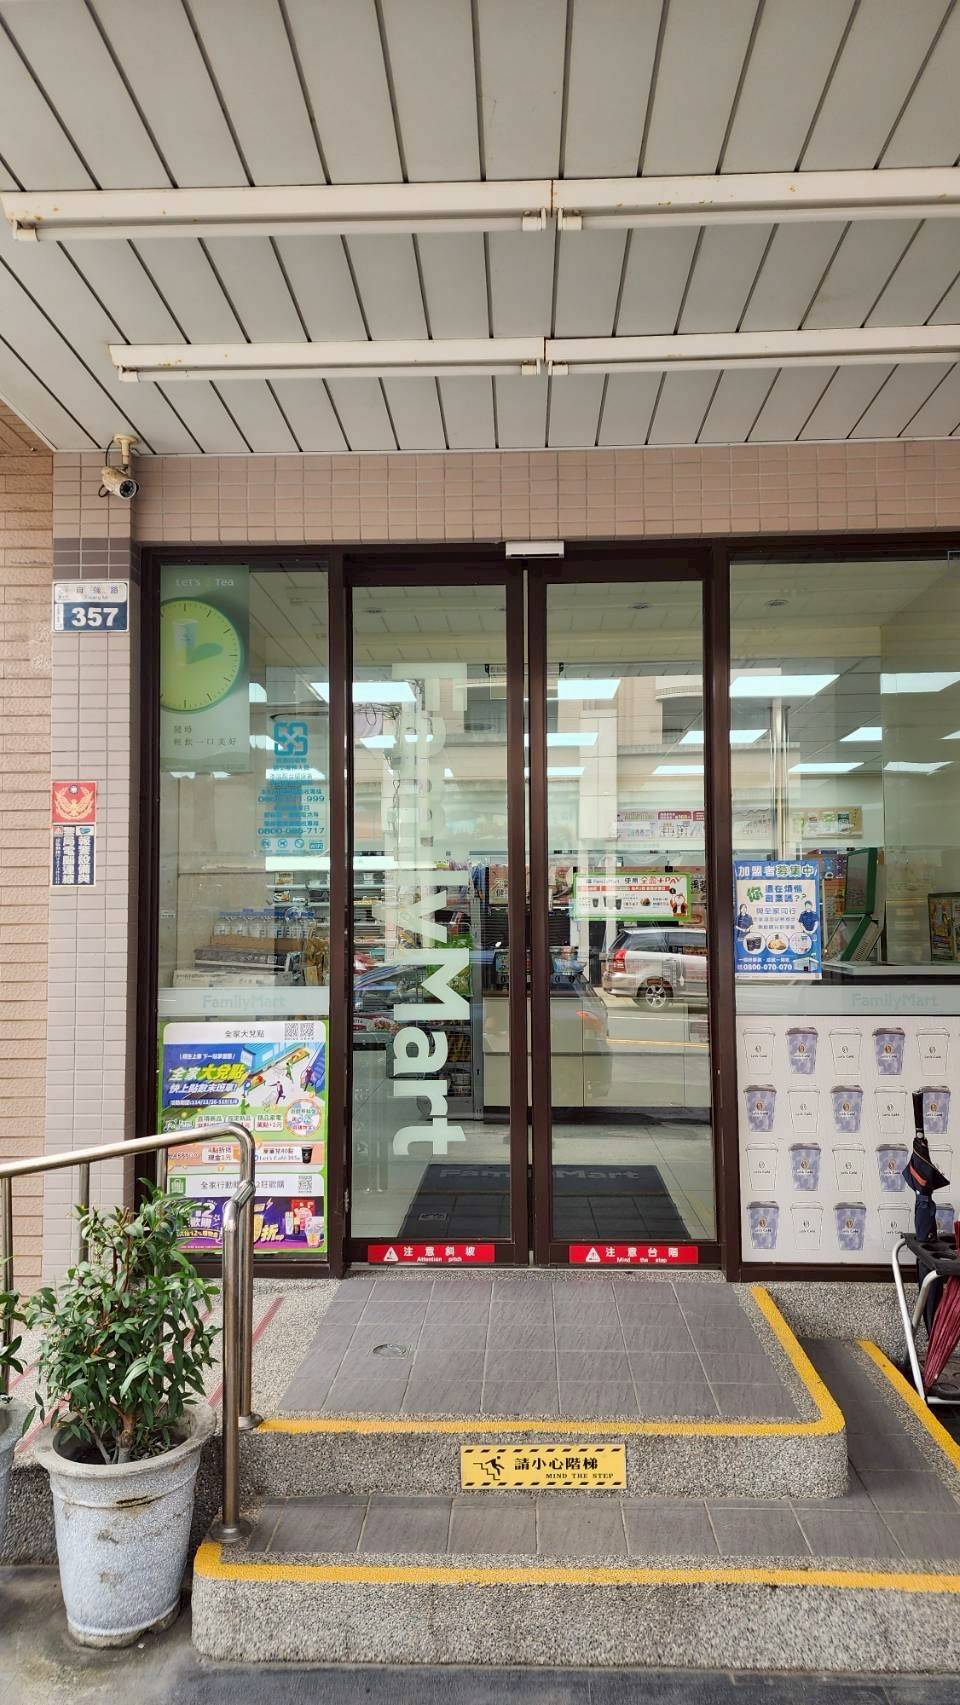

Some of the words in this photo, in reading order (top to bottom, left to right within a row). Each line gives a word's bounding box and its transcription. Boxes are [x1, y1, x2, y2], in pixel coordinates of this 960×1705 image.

[71, 607, 119, 627] 357
[203, 994, 287, 1010] FamilyMart
[851, 992, 938, 1010] FamilyMart
[440, 1169, 641, 1180] FamMart
[514, 1457, 598, 1471] 請小心階梯
